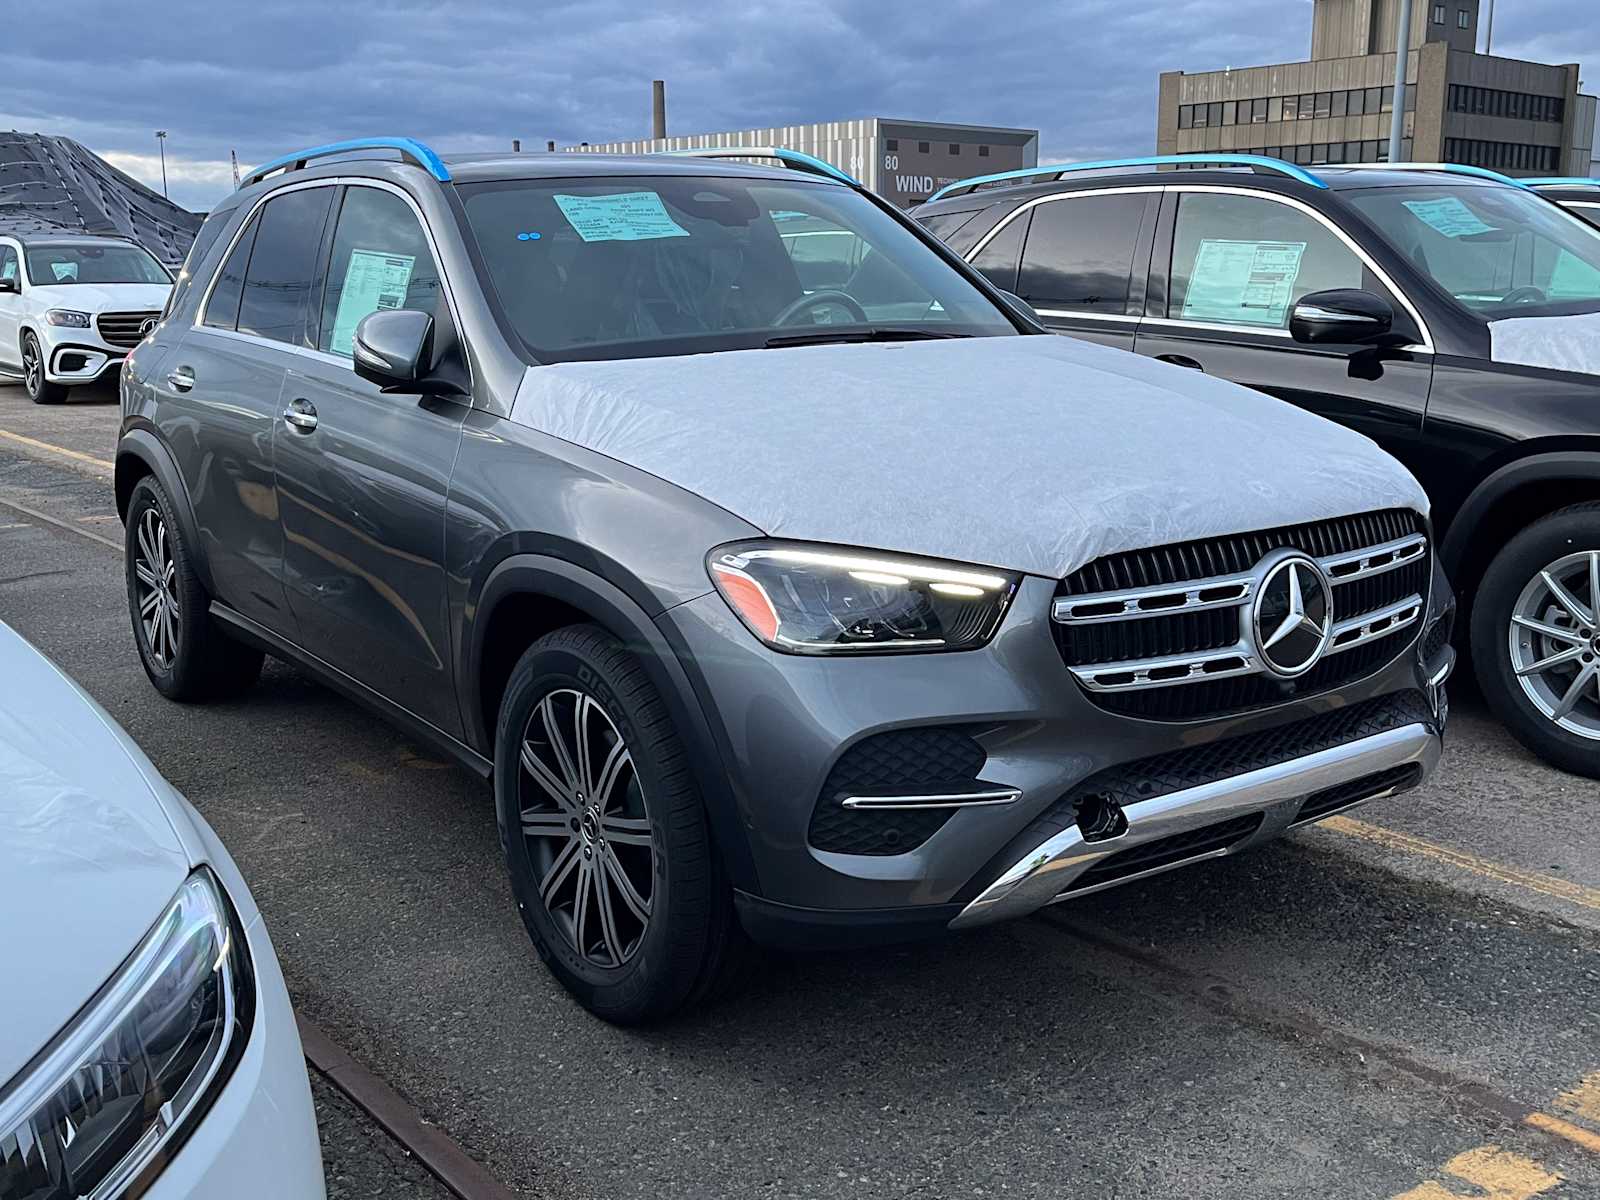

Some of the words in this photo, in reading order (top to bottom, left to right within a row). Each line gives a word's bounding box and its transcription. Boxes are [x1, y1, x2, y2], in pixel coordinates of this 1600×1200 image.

[850, 155, 863, 170] 80
[884, 155, 898, 171] 80
[896, 175, 934, 193] WIND
